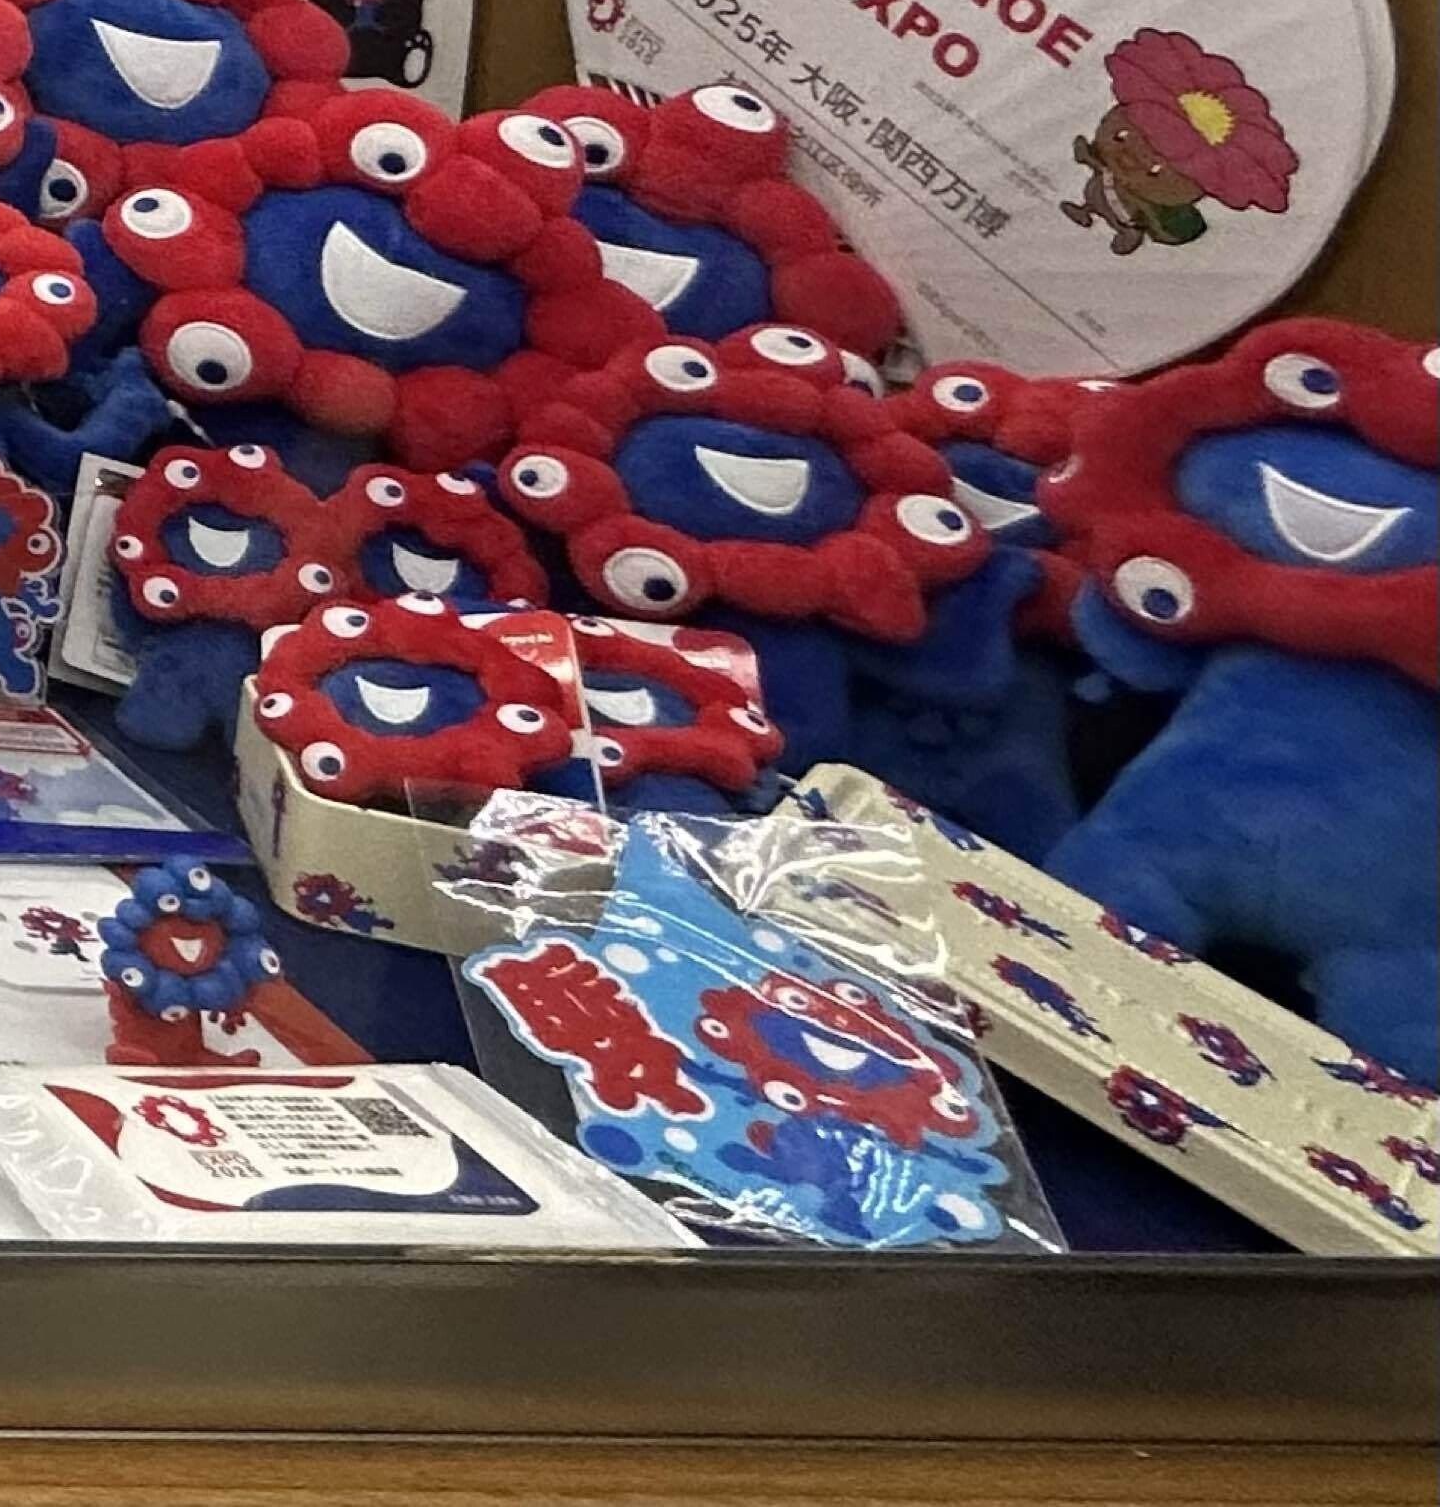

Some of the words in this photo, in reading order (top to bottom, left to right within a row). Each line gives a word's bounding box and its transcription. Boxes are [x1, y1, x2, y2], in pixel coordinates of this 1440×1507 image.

[790, 61, 1013, 240] 大阪・関西万博
